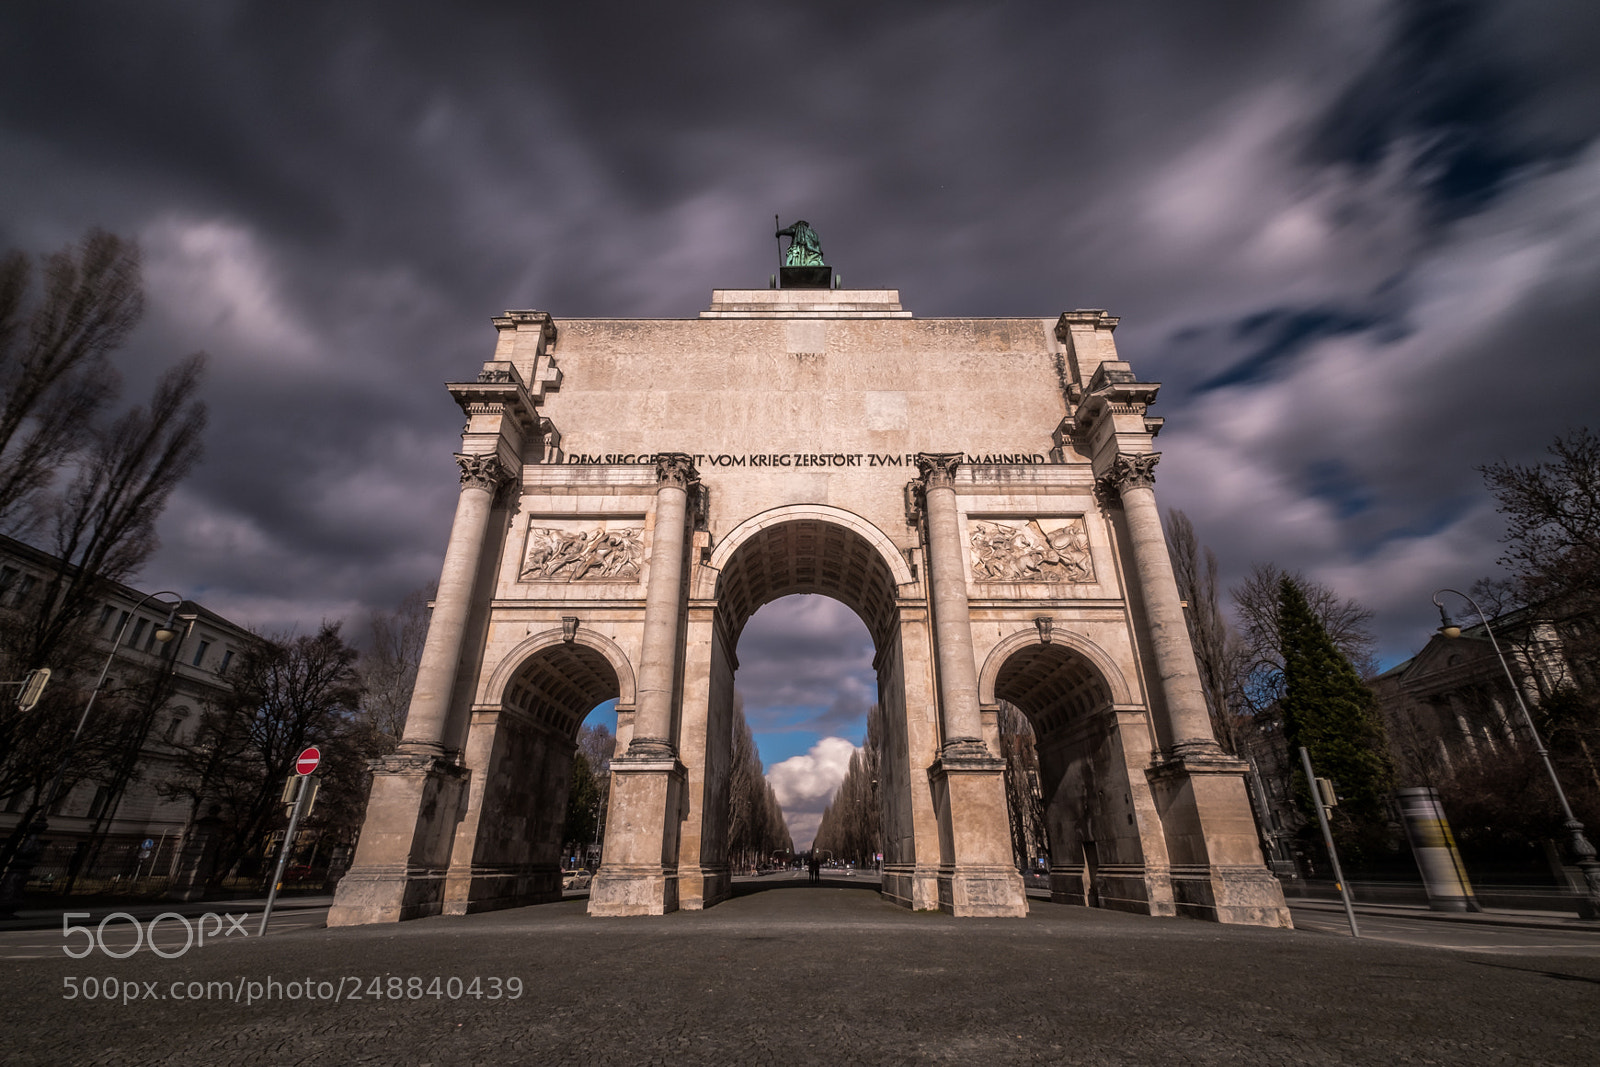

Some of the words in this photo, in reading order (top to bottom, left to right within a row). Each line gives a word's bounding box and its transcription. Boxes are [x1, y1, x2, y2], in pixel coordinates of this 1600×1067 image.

[568, 454, 602, 465] DEM
[605, 454, 636, 465] SIEG
[708, 454, 746, 467] VOM
[749, 454, 792, 467] KRIEG
[794, 452, 864, 467] ZERSTÖRT
[868, 454, 903, 467] ZVM
[967, 454, 1045, 465] MAHNEND
